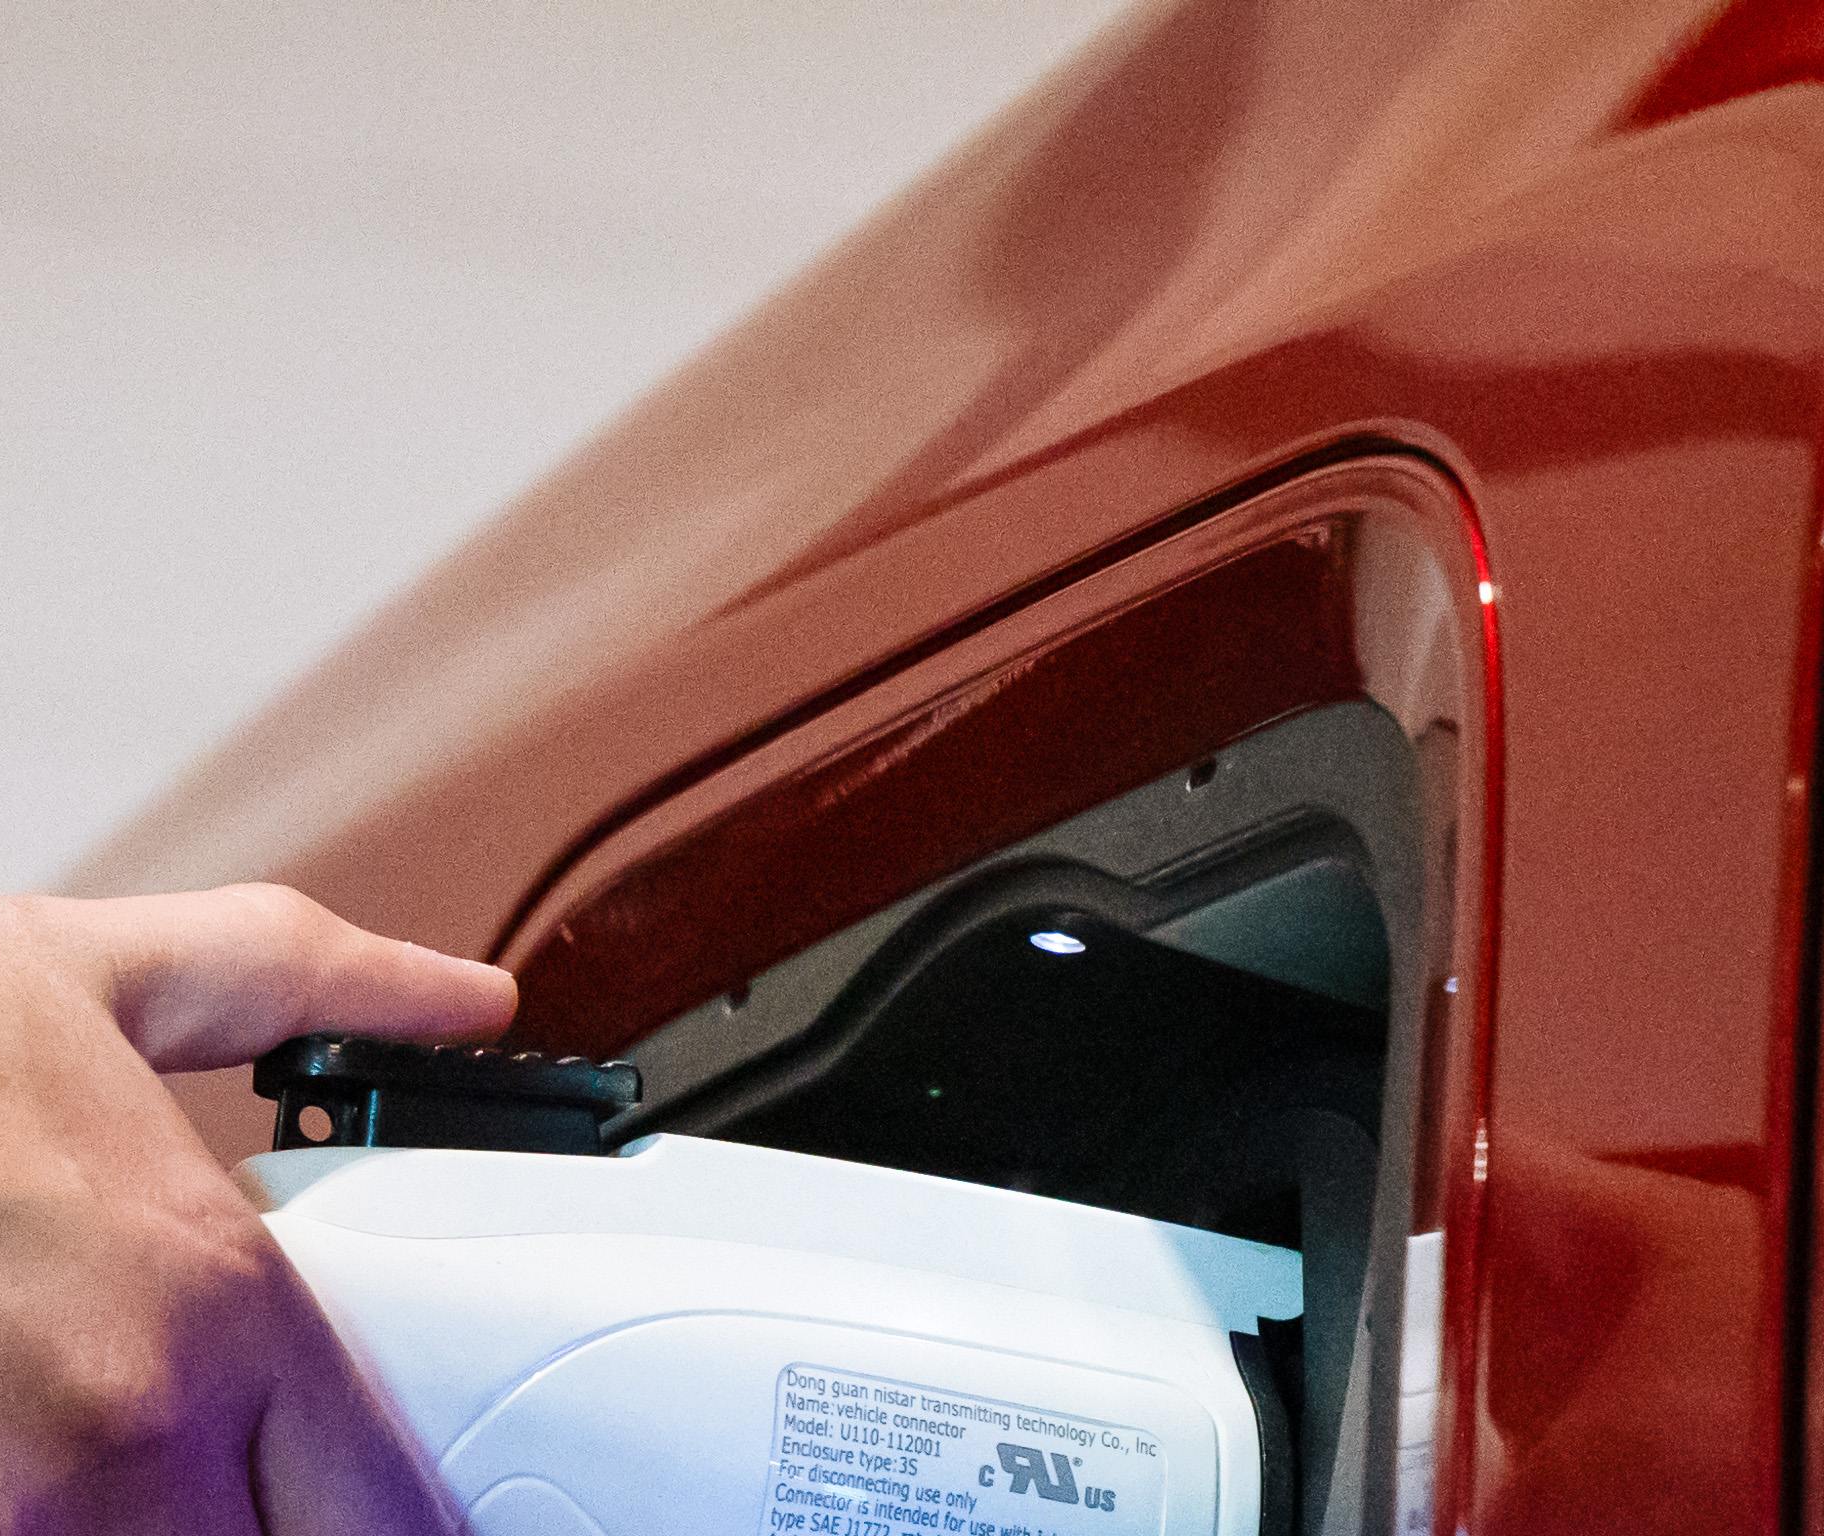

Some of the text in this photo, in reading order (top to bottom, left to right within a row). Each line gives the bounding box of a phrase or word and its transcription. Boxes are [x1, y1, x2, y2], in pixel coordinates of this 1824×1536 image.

[784, 1413, 941, 1457] Model: U110-112001
[787, 1369, 1157, 1457] Dong guan nistar transmitting technology Co., Inc
[893, 1413, 967, 1440] connector
[781, 1436, 854, 1464] Enclosure
[776, 1482, 852, 1511] Connector
[857, 1500, 869, 1515] is
[874, 1498, 939, 1528] intended
[943, 1511, 966, 1532] for
[779, 1459, 977, 1514] For disconnecting use only
[771, 1507, 805, 1532] type
[810, 1512, 842, 1536] SAE
